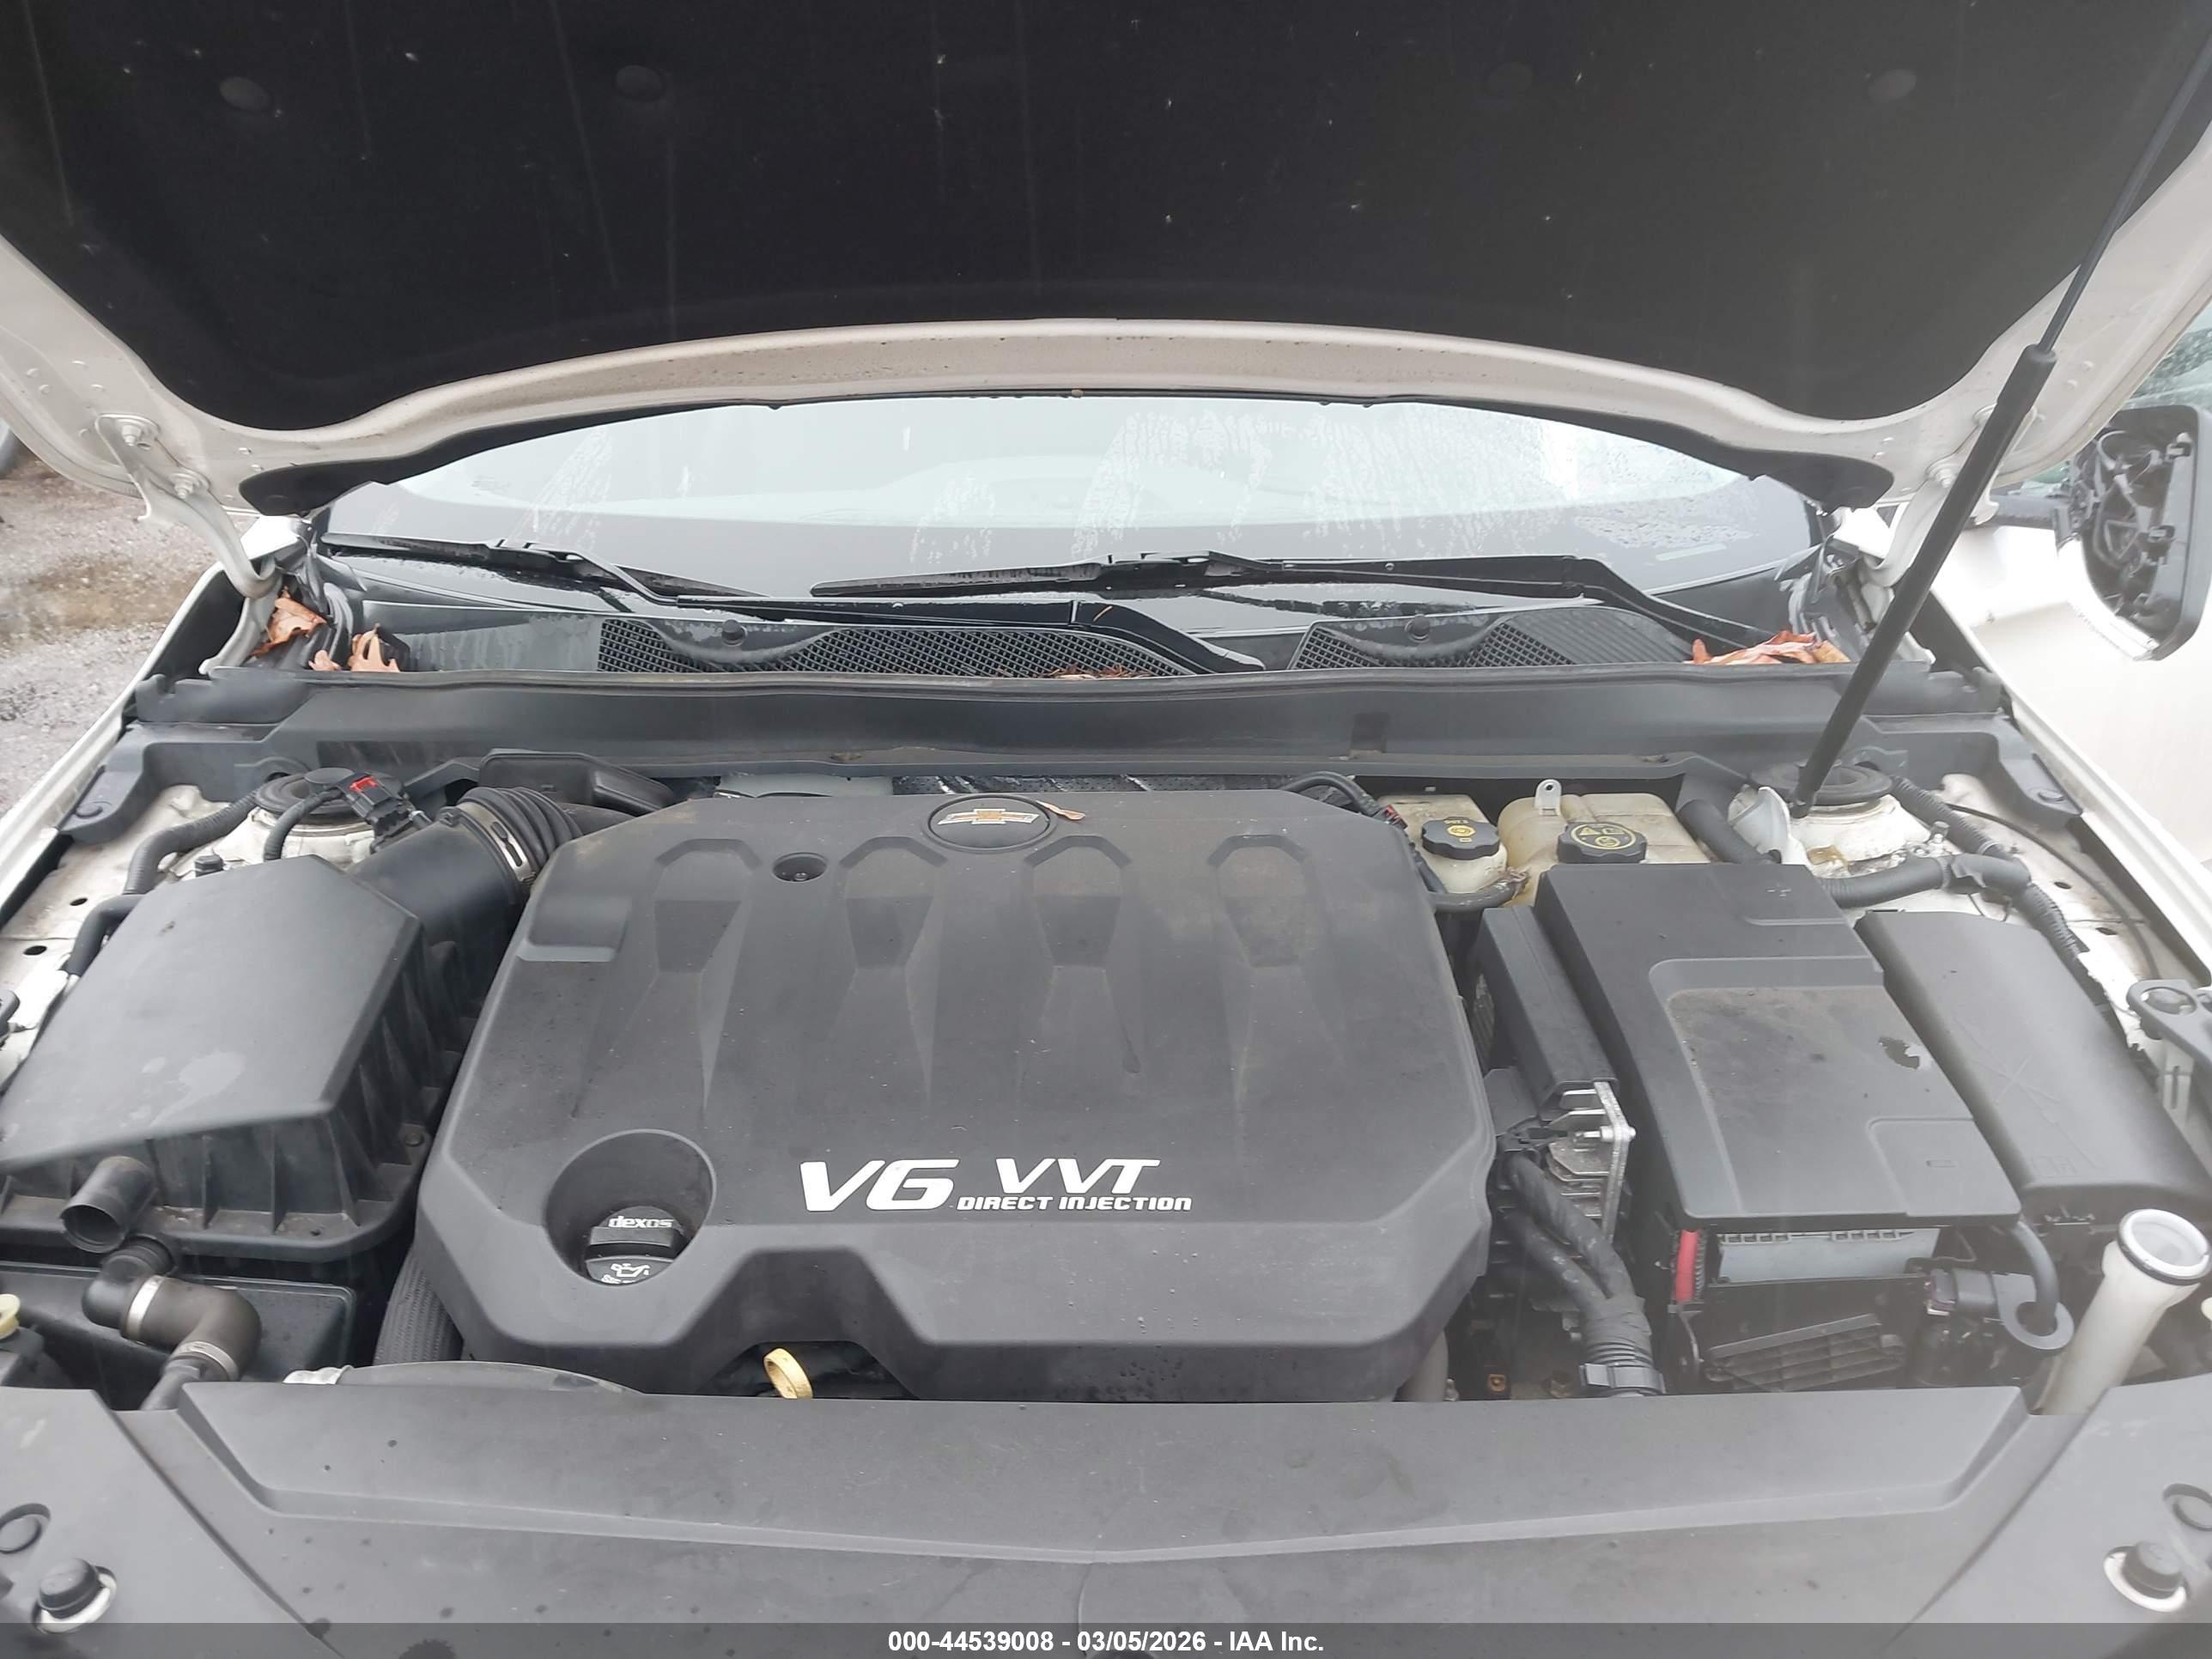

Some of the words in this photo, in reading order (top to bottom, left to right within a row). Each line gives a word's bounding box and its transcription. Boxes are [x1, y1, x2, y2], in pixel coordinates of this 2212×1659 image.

[799, 1159, 960, 1212] V6
[996, 1158, 1161, 1194] VVT
[957, 1196, 1054, 1211] DIRECT
[1059, 1196, 1192, 1211] INJECTION
[608, 1215, 674, 1229] dexos
